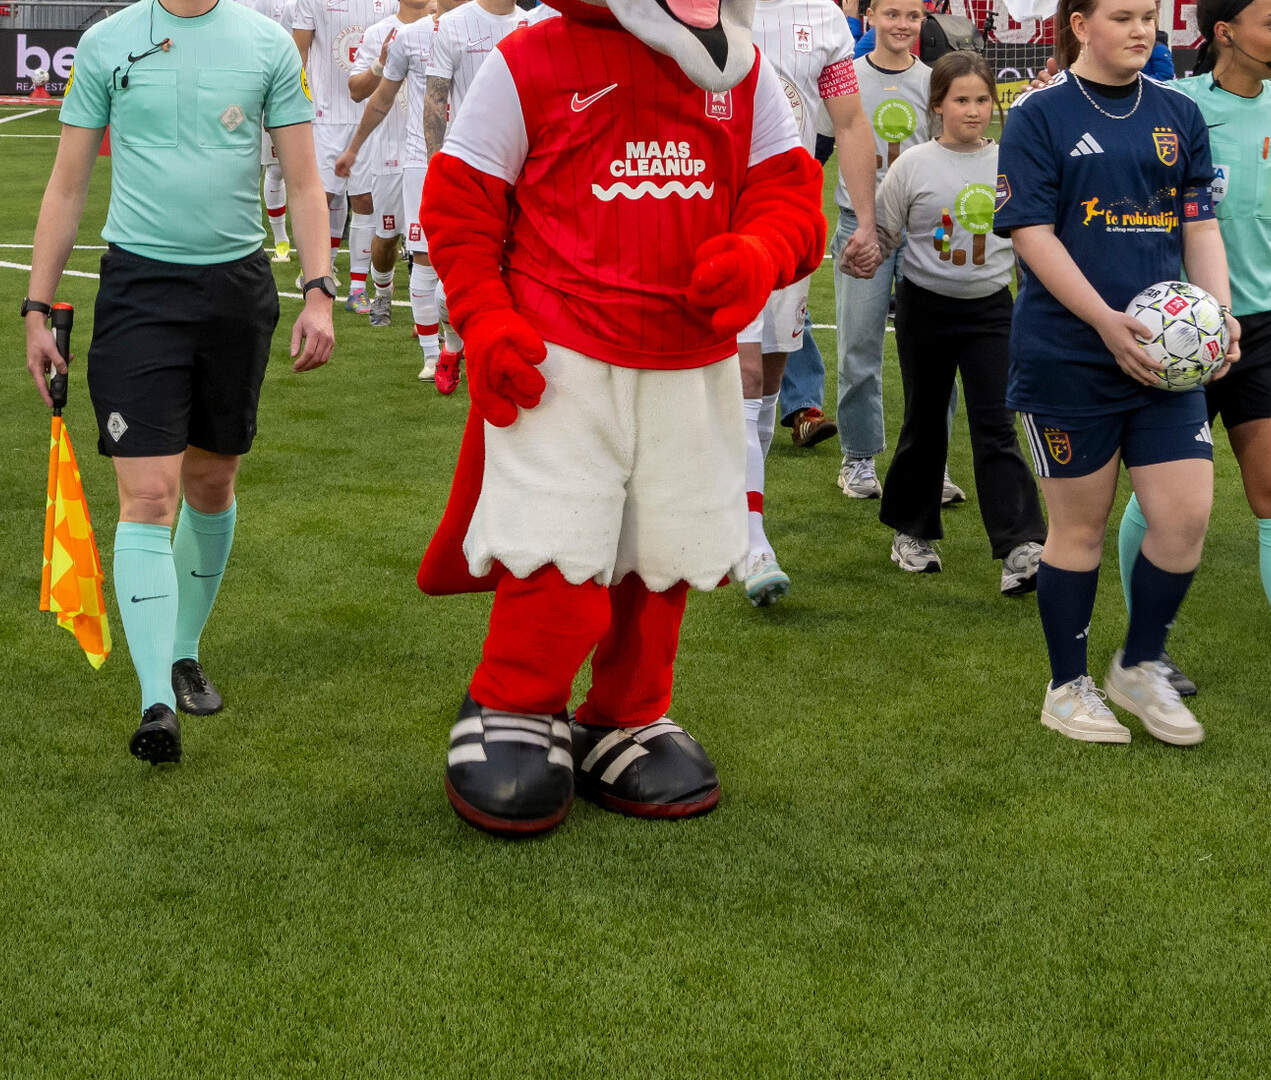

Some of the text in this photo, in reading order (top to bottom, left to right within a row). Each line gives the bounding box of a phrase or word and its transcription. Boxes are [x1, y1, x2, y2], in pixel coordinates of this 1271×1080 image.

[16, 82, 37, 91] REA
[711, 104, 727, 113] MVV
[625, 140, 691, 159] MAAS
[609, 158, 706, 178] CLEANUP
[1104, 210, 1121, 226] fc
